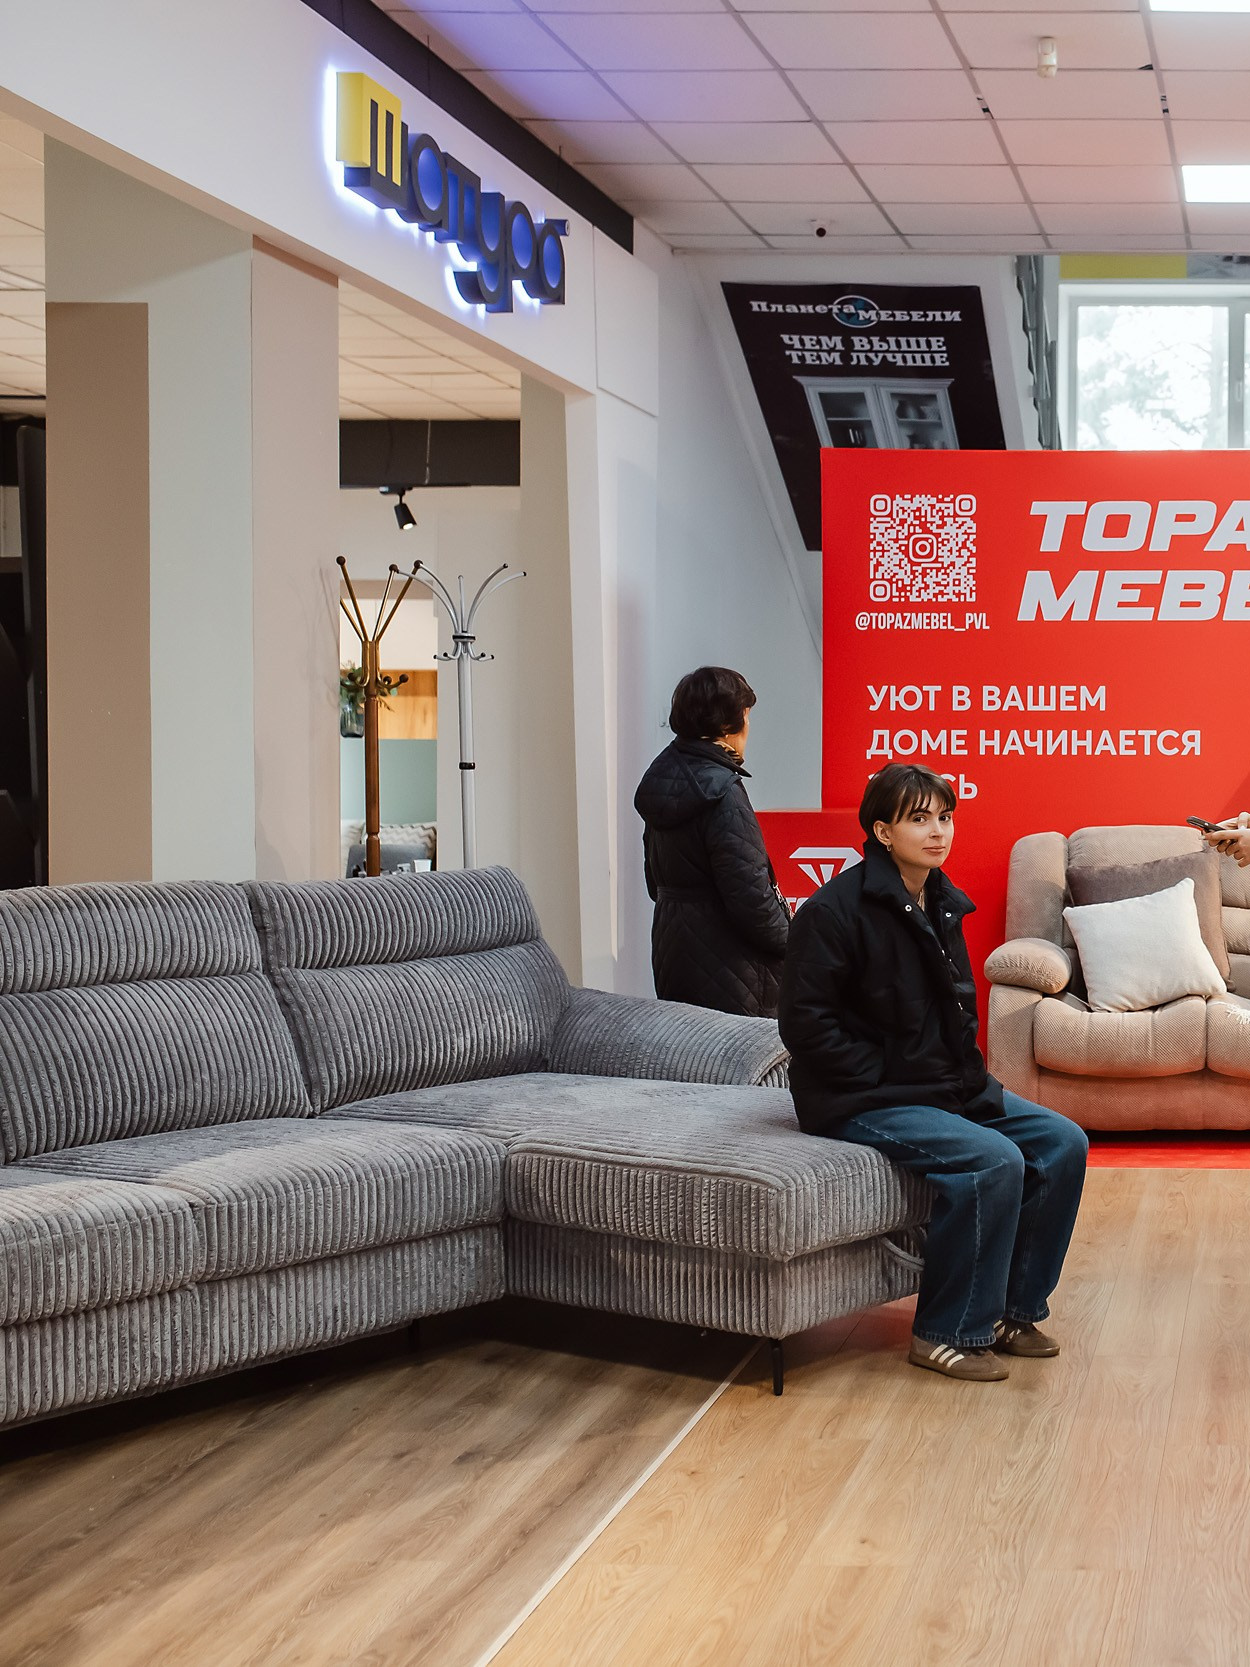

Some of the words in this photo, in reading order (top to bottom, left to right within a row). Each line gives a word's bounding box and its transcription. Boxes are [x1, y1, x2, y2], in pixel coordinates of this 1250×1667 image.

[750, 300, 856, 315] Планета
[780, 334, 845, 350] ЧЕМ
[852, 336, 947, 351] ВЫШЕ
[785, 351, 843, 365] ТЕМ
[850, 352, 950, 367] ЛУЧШЕ
[855, 611, 990, 632] @TOPAZMEBEL_PVL
[867, 685, 942, 712] УЮТ
[952, 685, 971, 711] В
[982, 685, 1106, 711] ВАШЕМ
[866, 729, 968, 760] ДОМЕ
[978, 729, 1201, 756] НАЧИНАЕТСЯ
